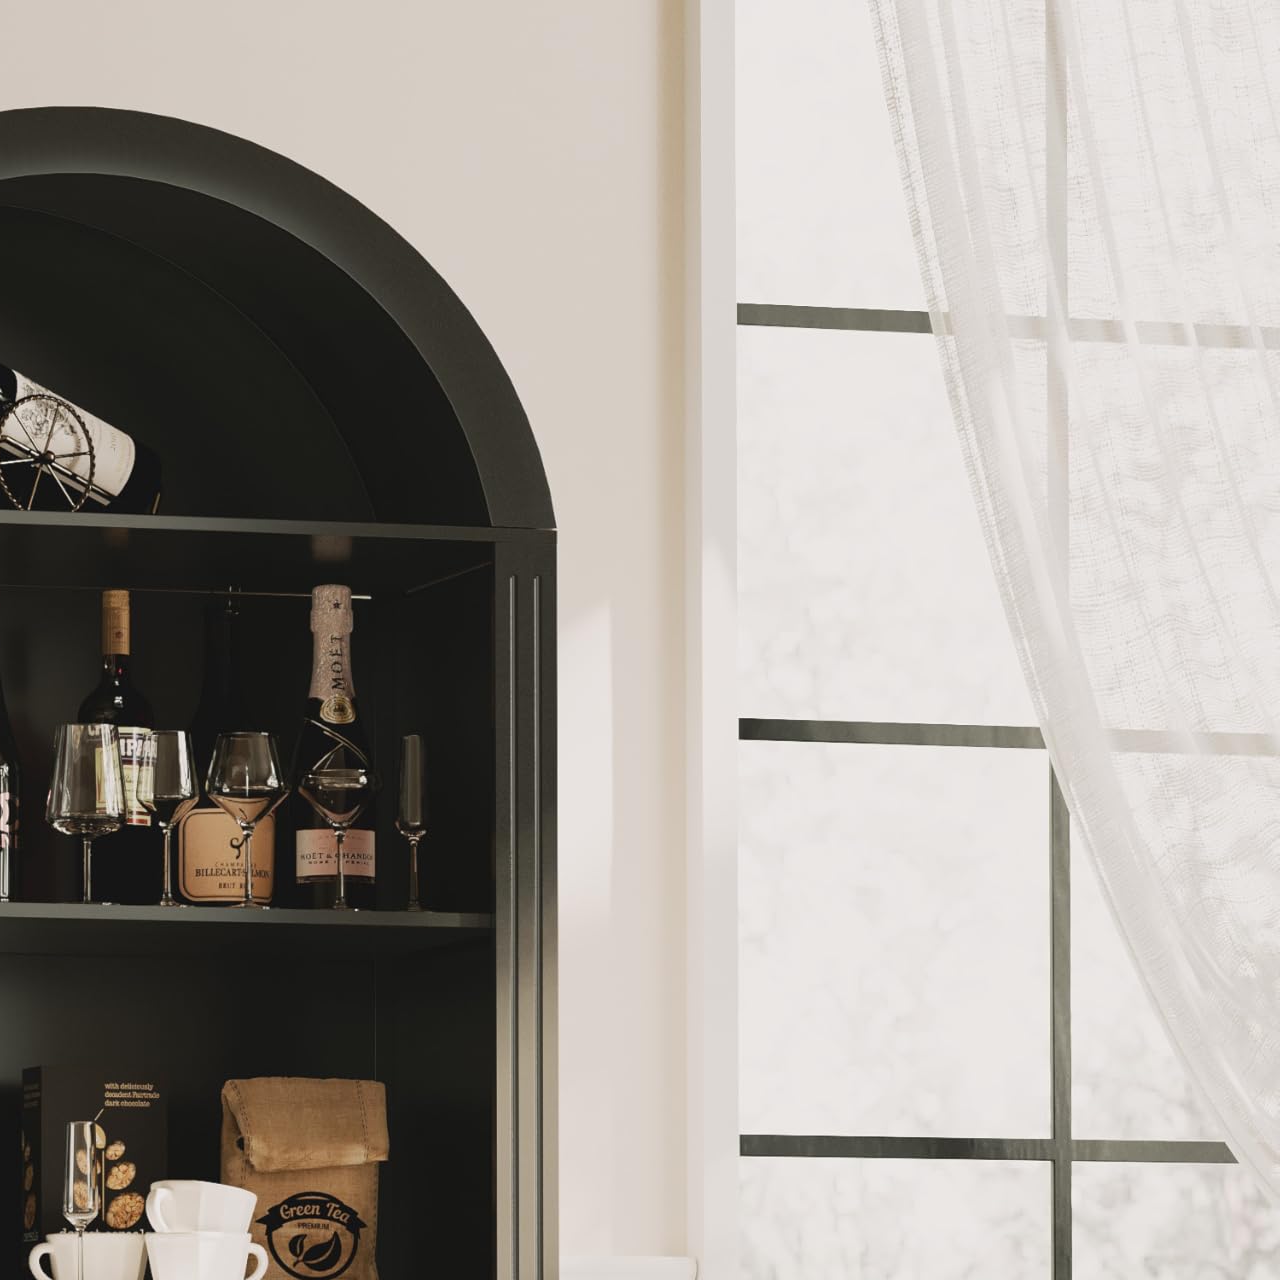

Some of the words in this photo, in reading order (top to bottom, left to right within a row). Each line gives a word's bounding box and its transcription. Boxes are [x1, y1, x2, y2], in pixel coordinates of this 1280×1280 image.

[104, 1082, 120, 1090] with
[280, 1204, 321, 1220] Green
[326, 1202, 352, 1223] Tea
[297, 1223, 330, 1231] PREMIUM
